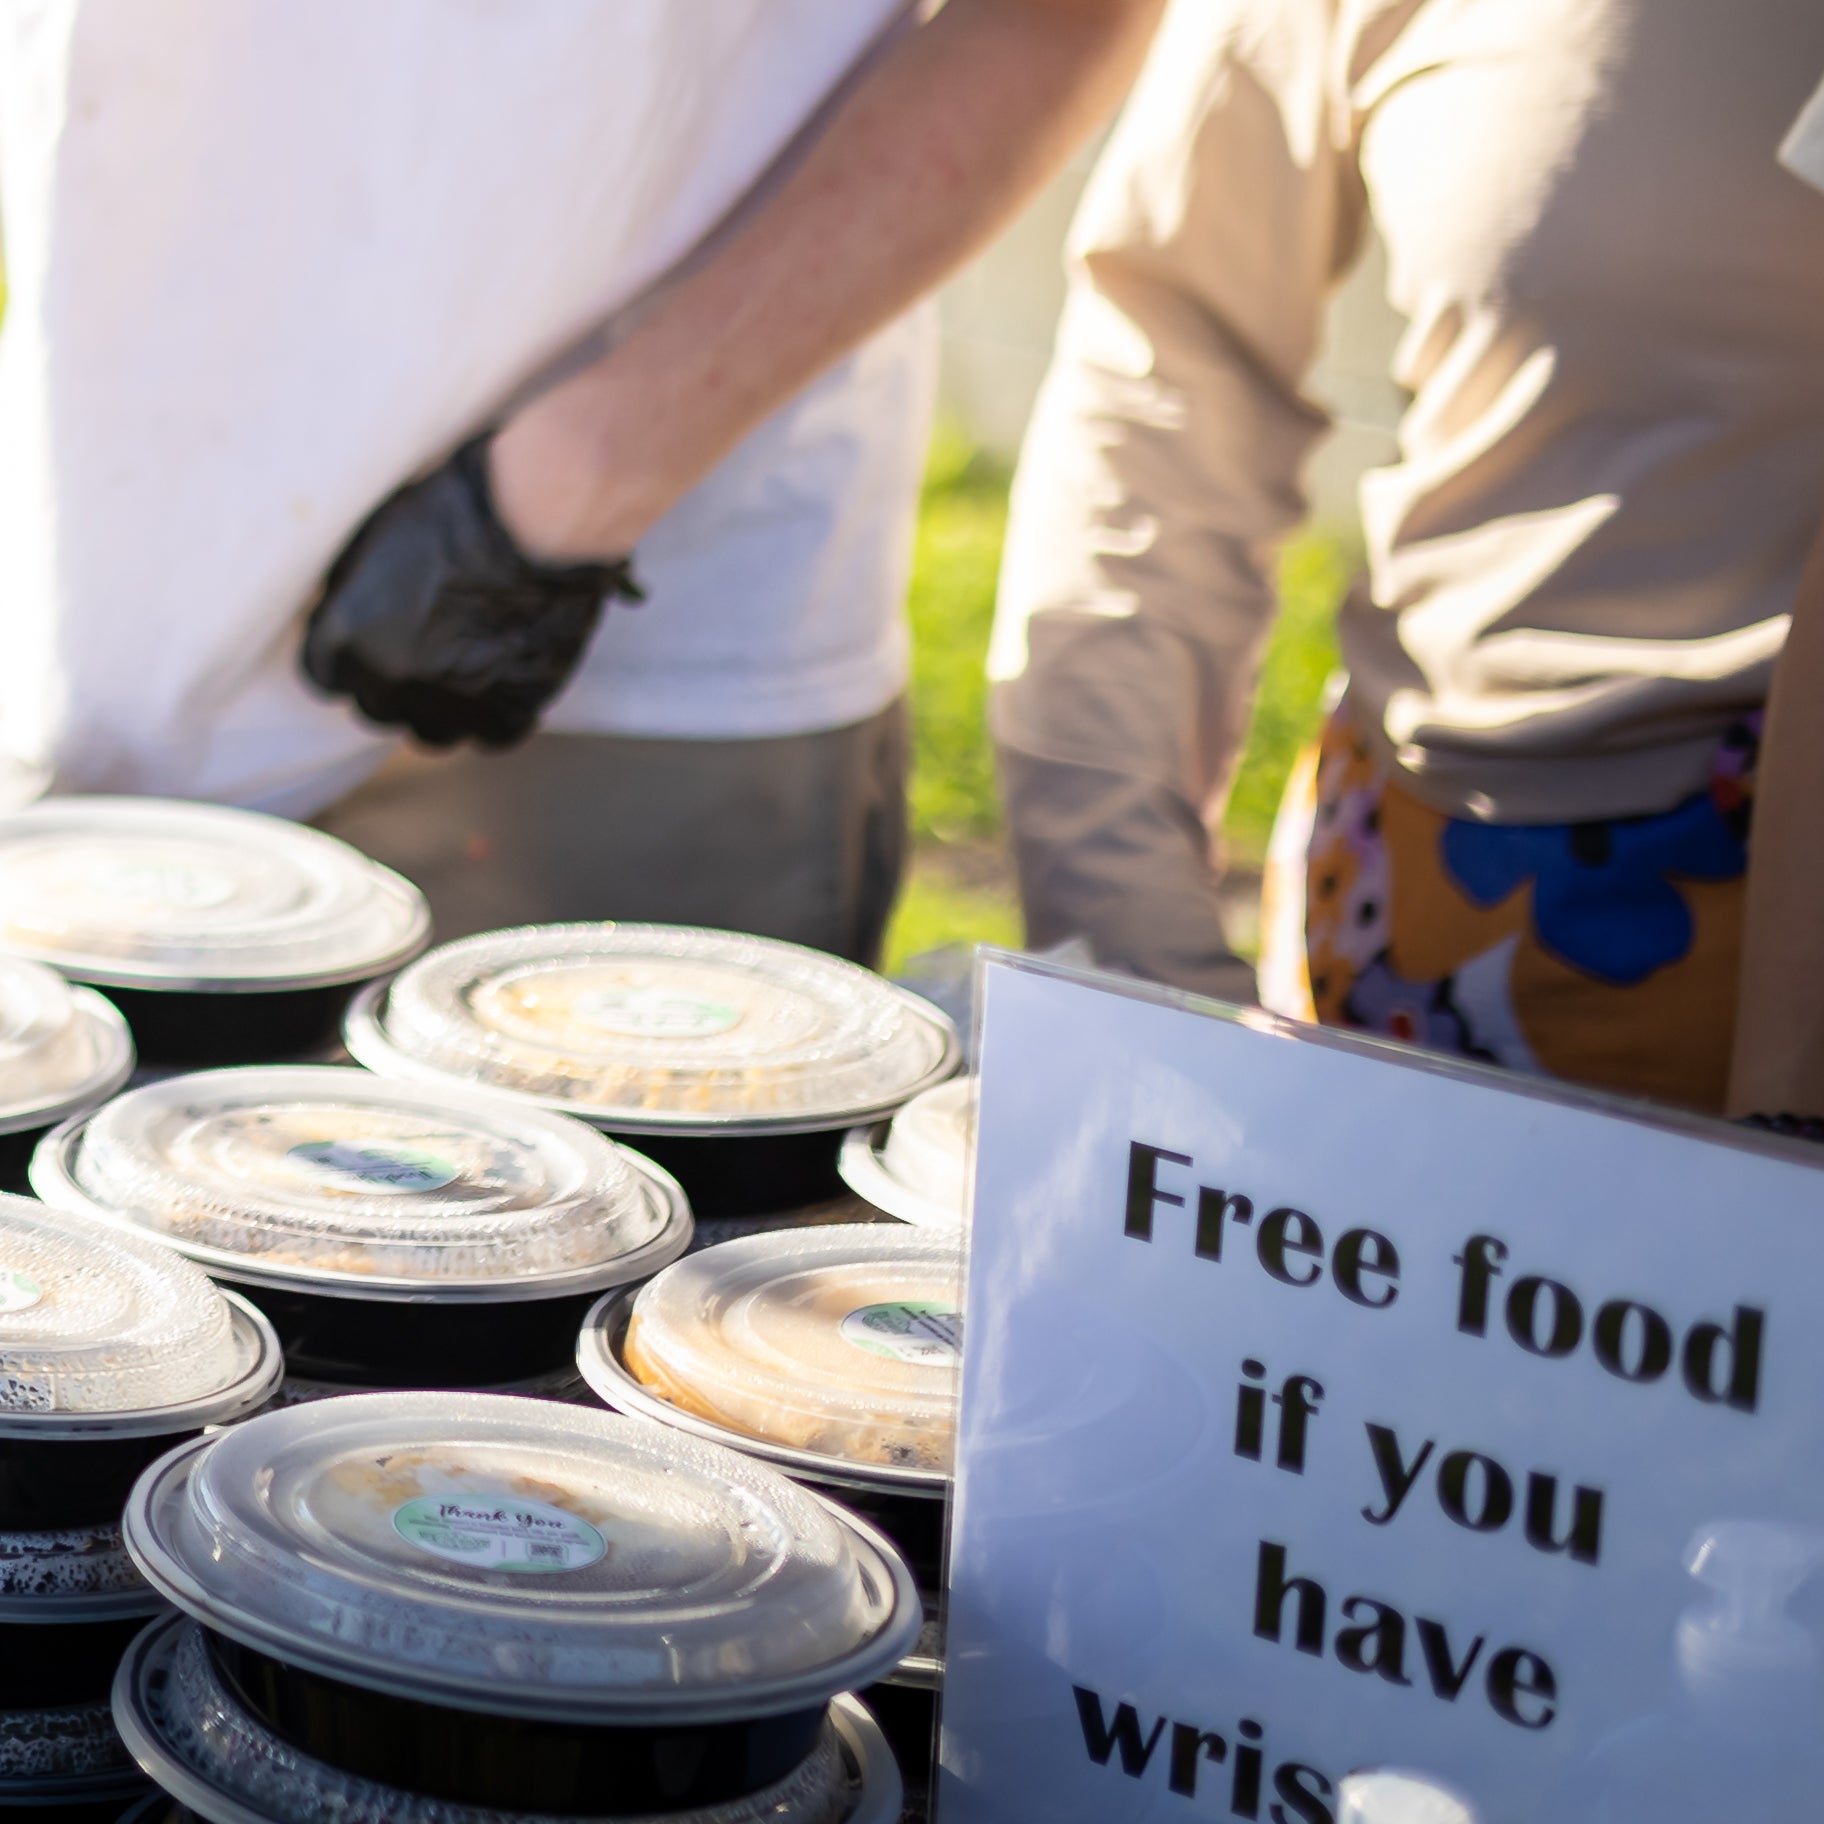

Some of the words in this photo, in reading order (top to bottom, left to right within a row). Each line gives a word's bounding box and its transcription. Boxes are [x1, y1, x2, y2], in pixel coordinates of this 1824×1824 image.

[1123, 1140, 1401, 1309] Free
[1453, 1233, 1768, 1415] food
[1233, 1358, 1326, 1476] if
[1362, 1421, 1605, 1567] you
[1252, 1539, 1559, 1731] have
[1072, 1684, 1336, 1824] wris
